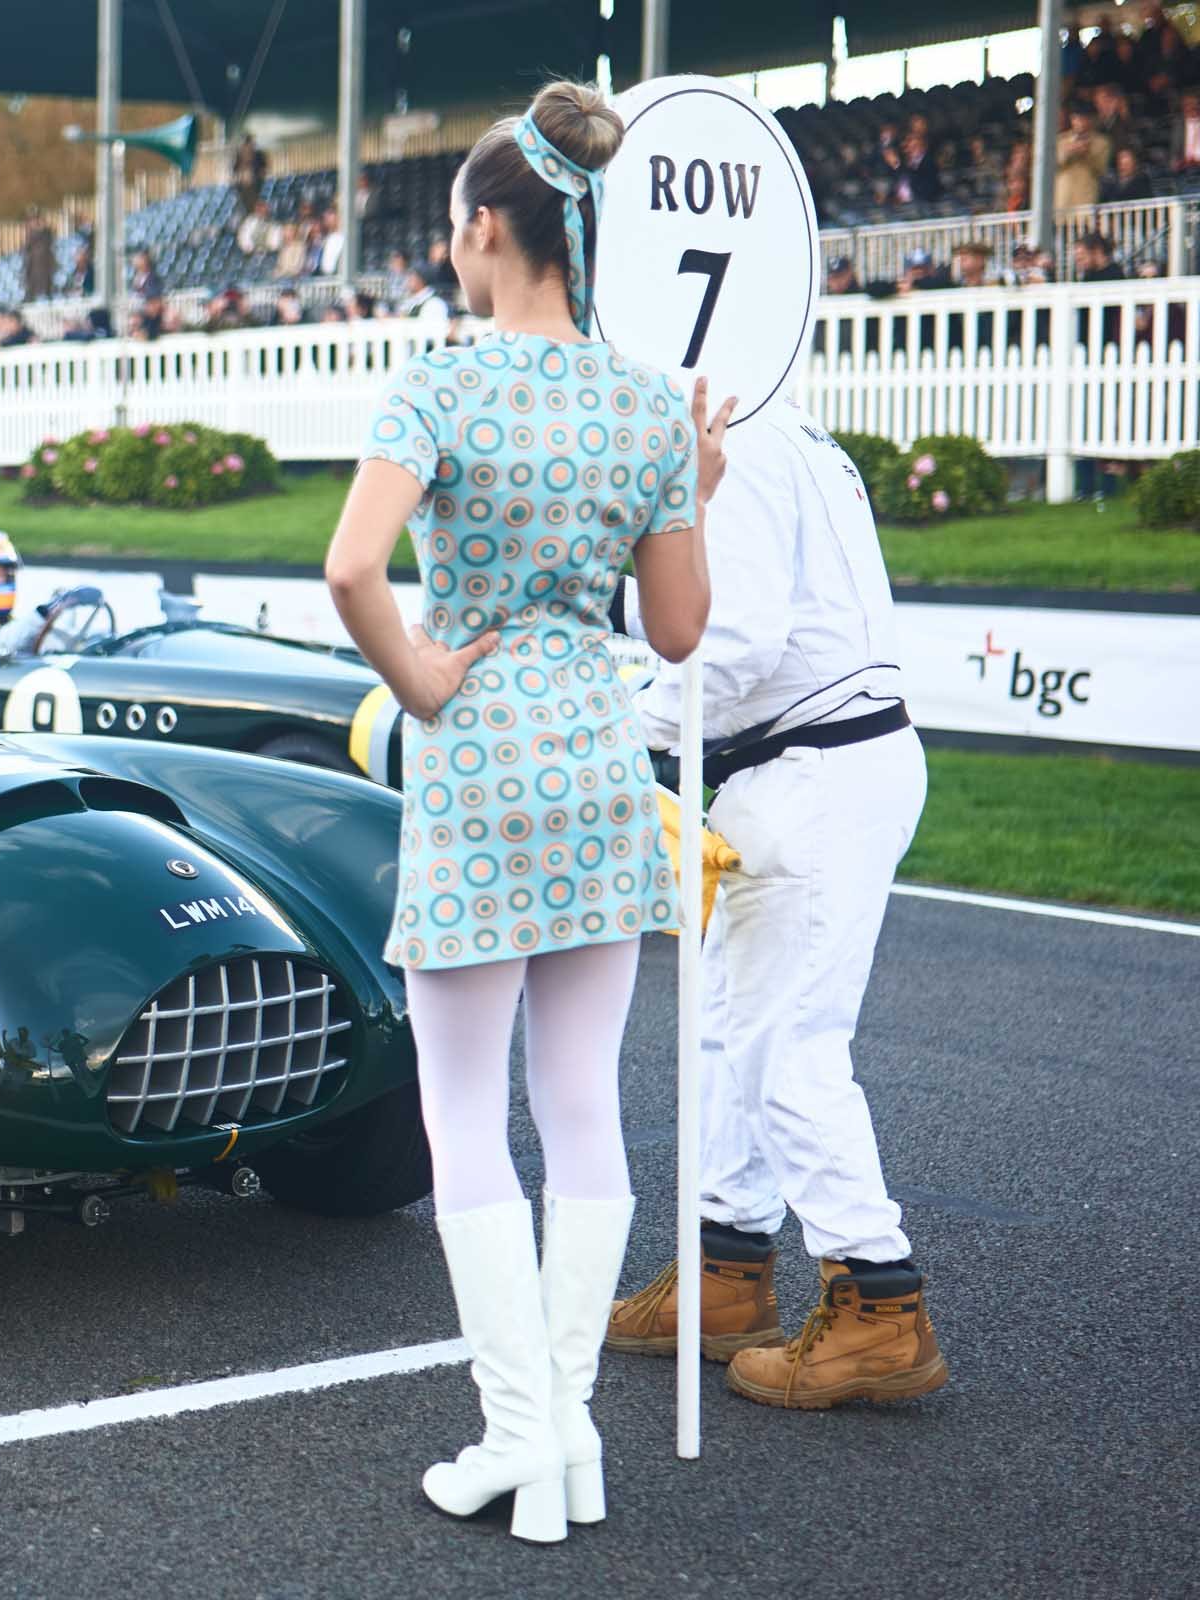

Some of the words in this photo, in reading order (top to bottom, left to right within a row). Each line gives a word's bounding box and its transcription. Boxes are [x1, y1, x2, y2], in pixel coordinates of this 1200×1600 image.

[649, 154, 762, 220] ROW
[677, 248, 732, 369] 7
[1010, 650, 1091, 718] bgc
[160, 898, 228, 929] LWM
